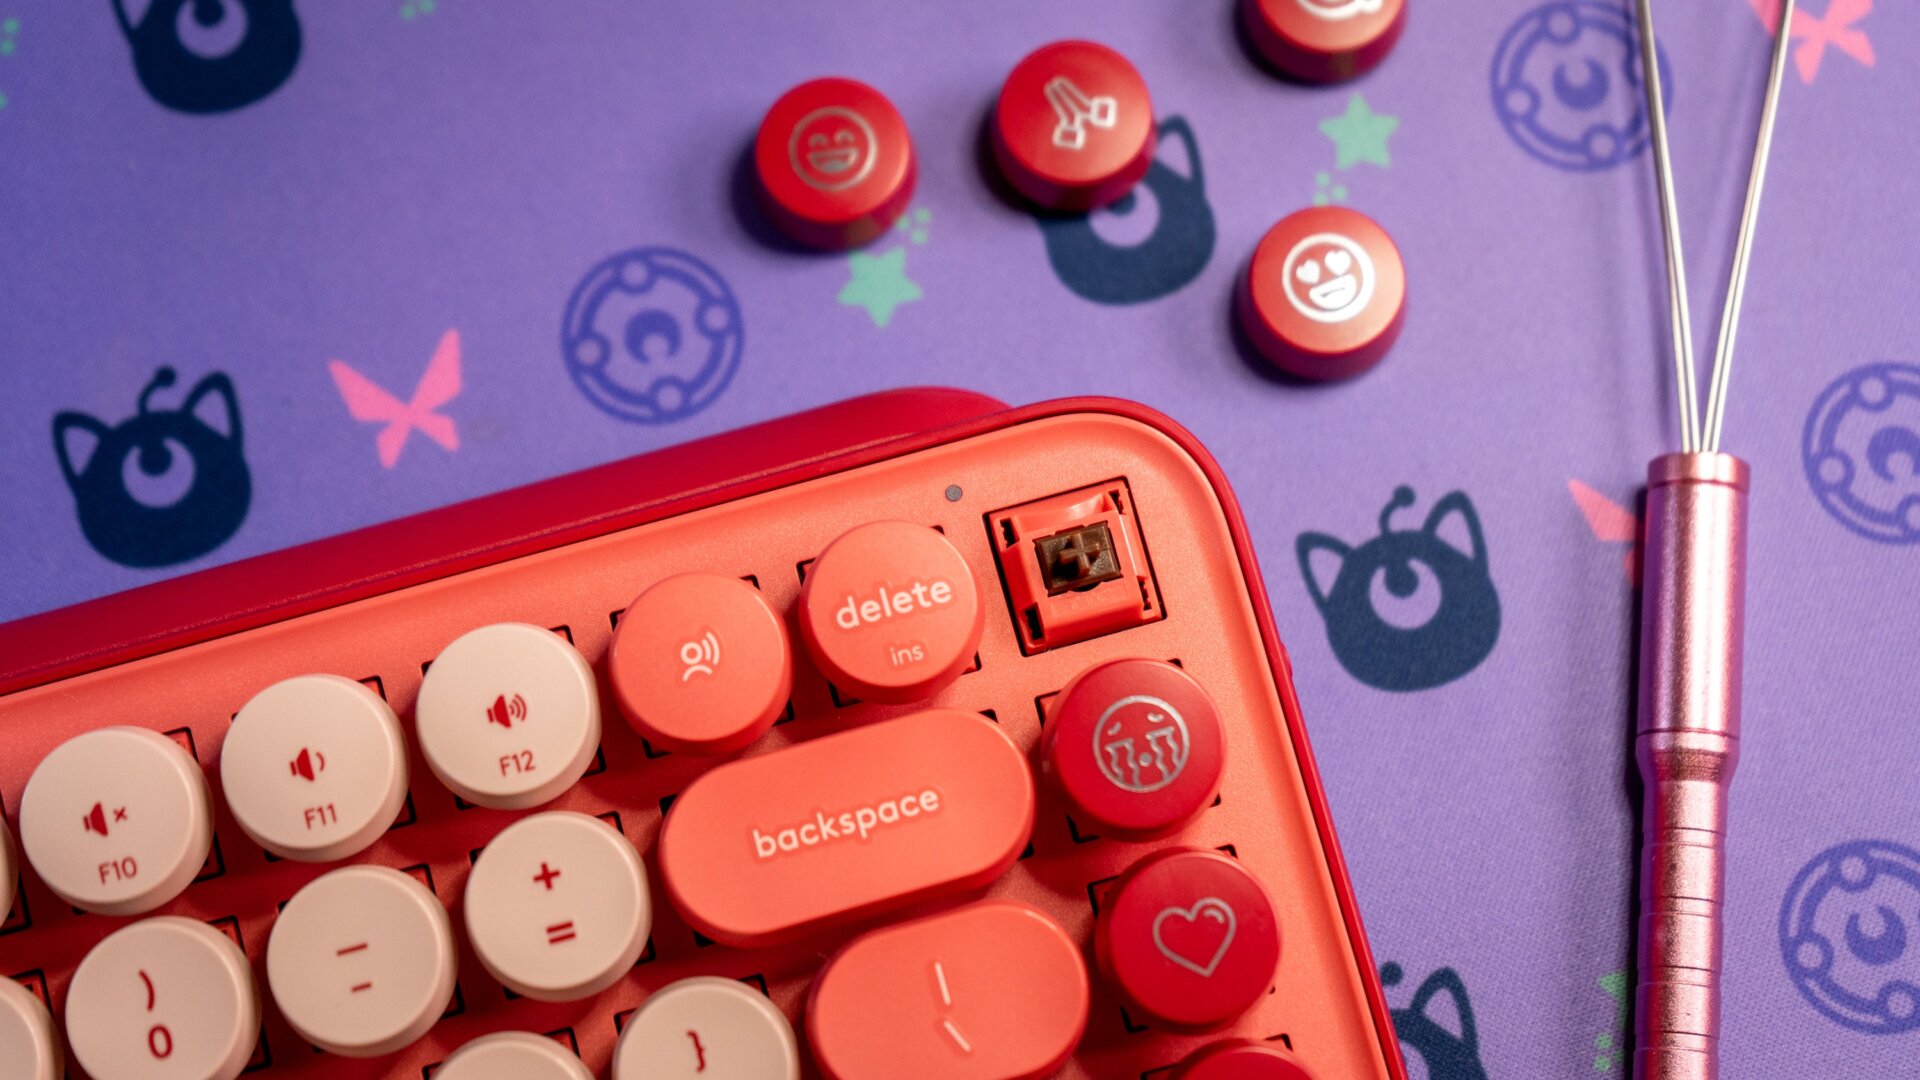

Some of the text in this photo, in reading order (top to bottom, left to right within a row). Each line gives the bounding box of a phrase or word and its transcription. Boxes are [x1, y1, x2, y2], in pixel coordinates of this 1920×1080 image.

[836, 581, 952, 629] delete
[889, 646, 924, 666] ins
[499, 750, 536, 777] F12
[304, 803, 337, 830] F11
[753, 790, 939, 858] backspace
[98, 856, 137, 885] F10
